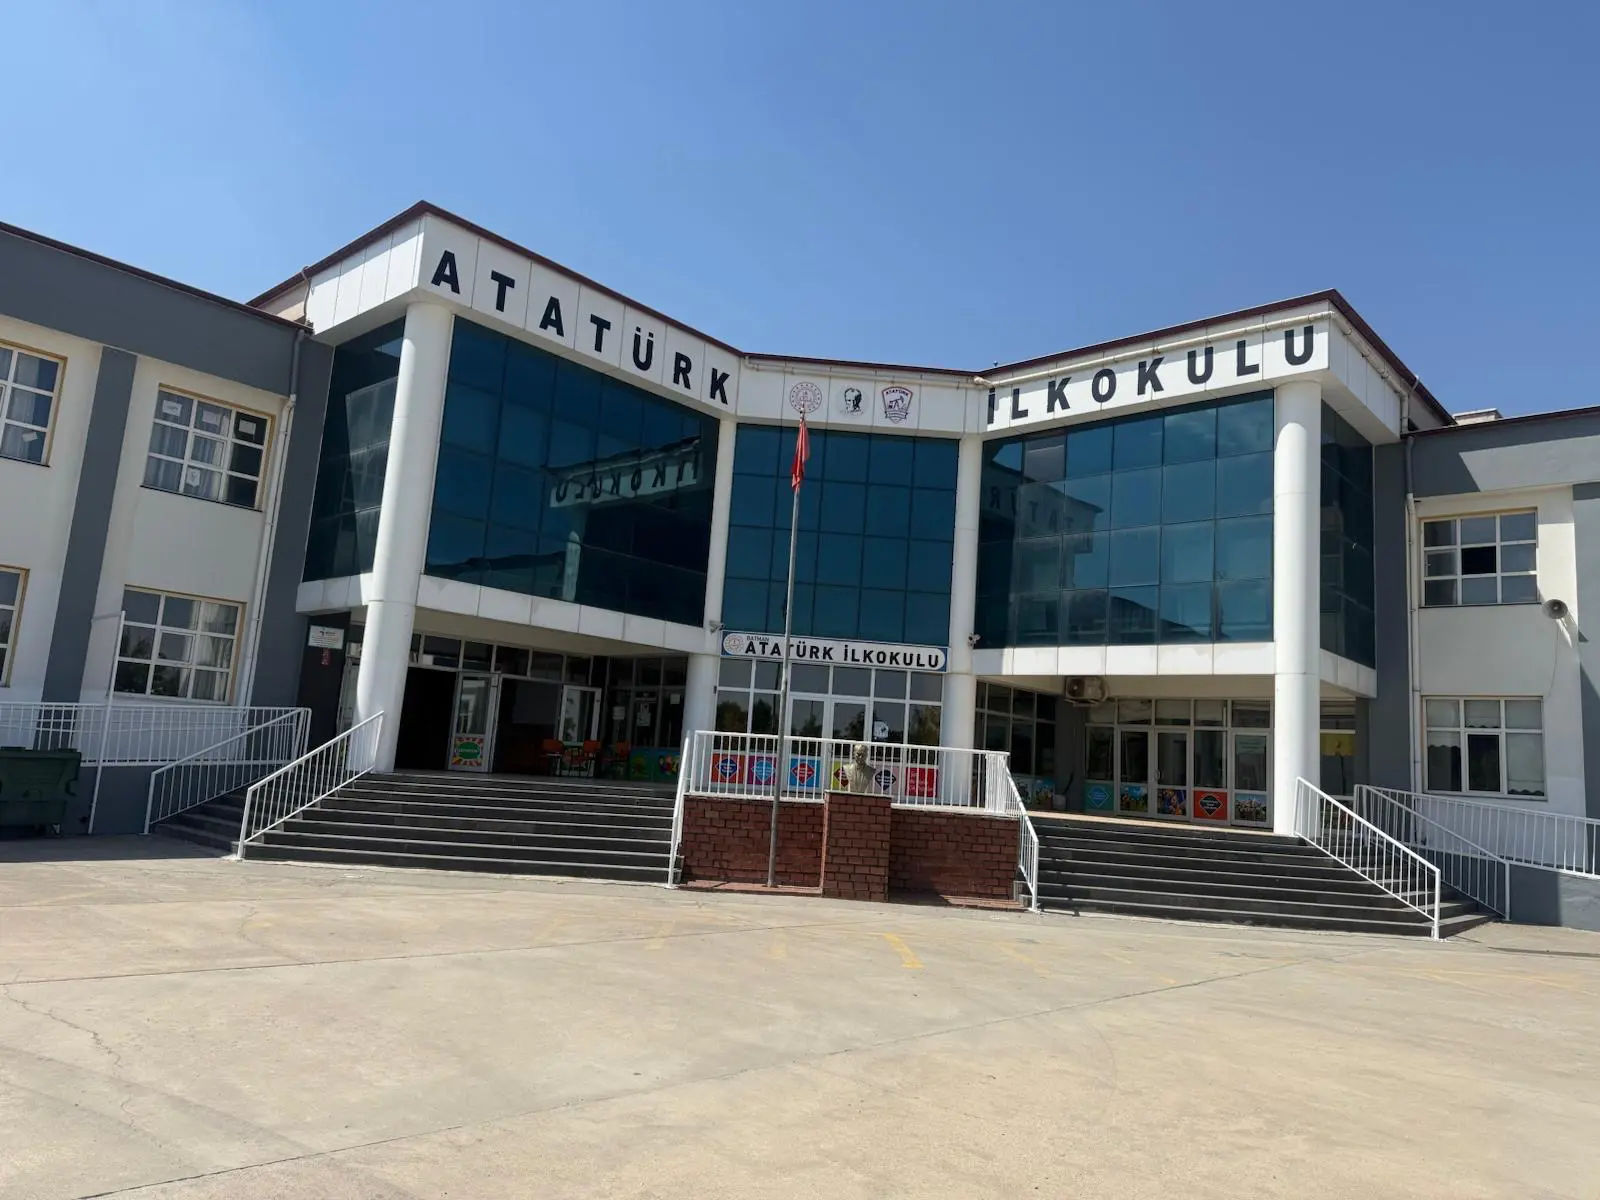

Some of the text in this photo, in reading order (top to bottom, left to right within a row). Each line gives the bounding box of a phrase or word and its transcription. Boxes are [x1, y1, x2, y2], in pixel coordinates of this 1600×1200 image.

[431, 250, 1315, 425] ATATÜRK İLKOKULU
[843, 644, 939, 669] İLKOKULU
